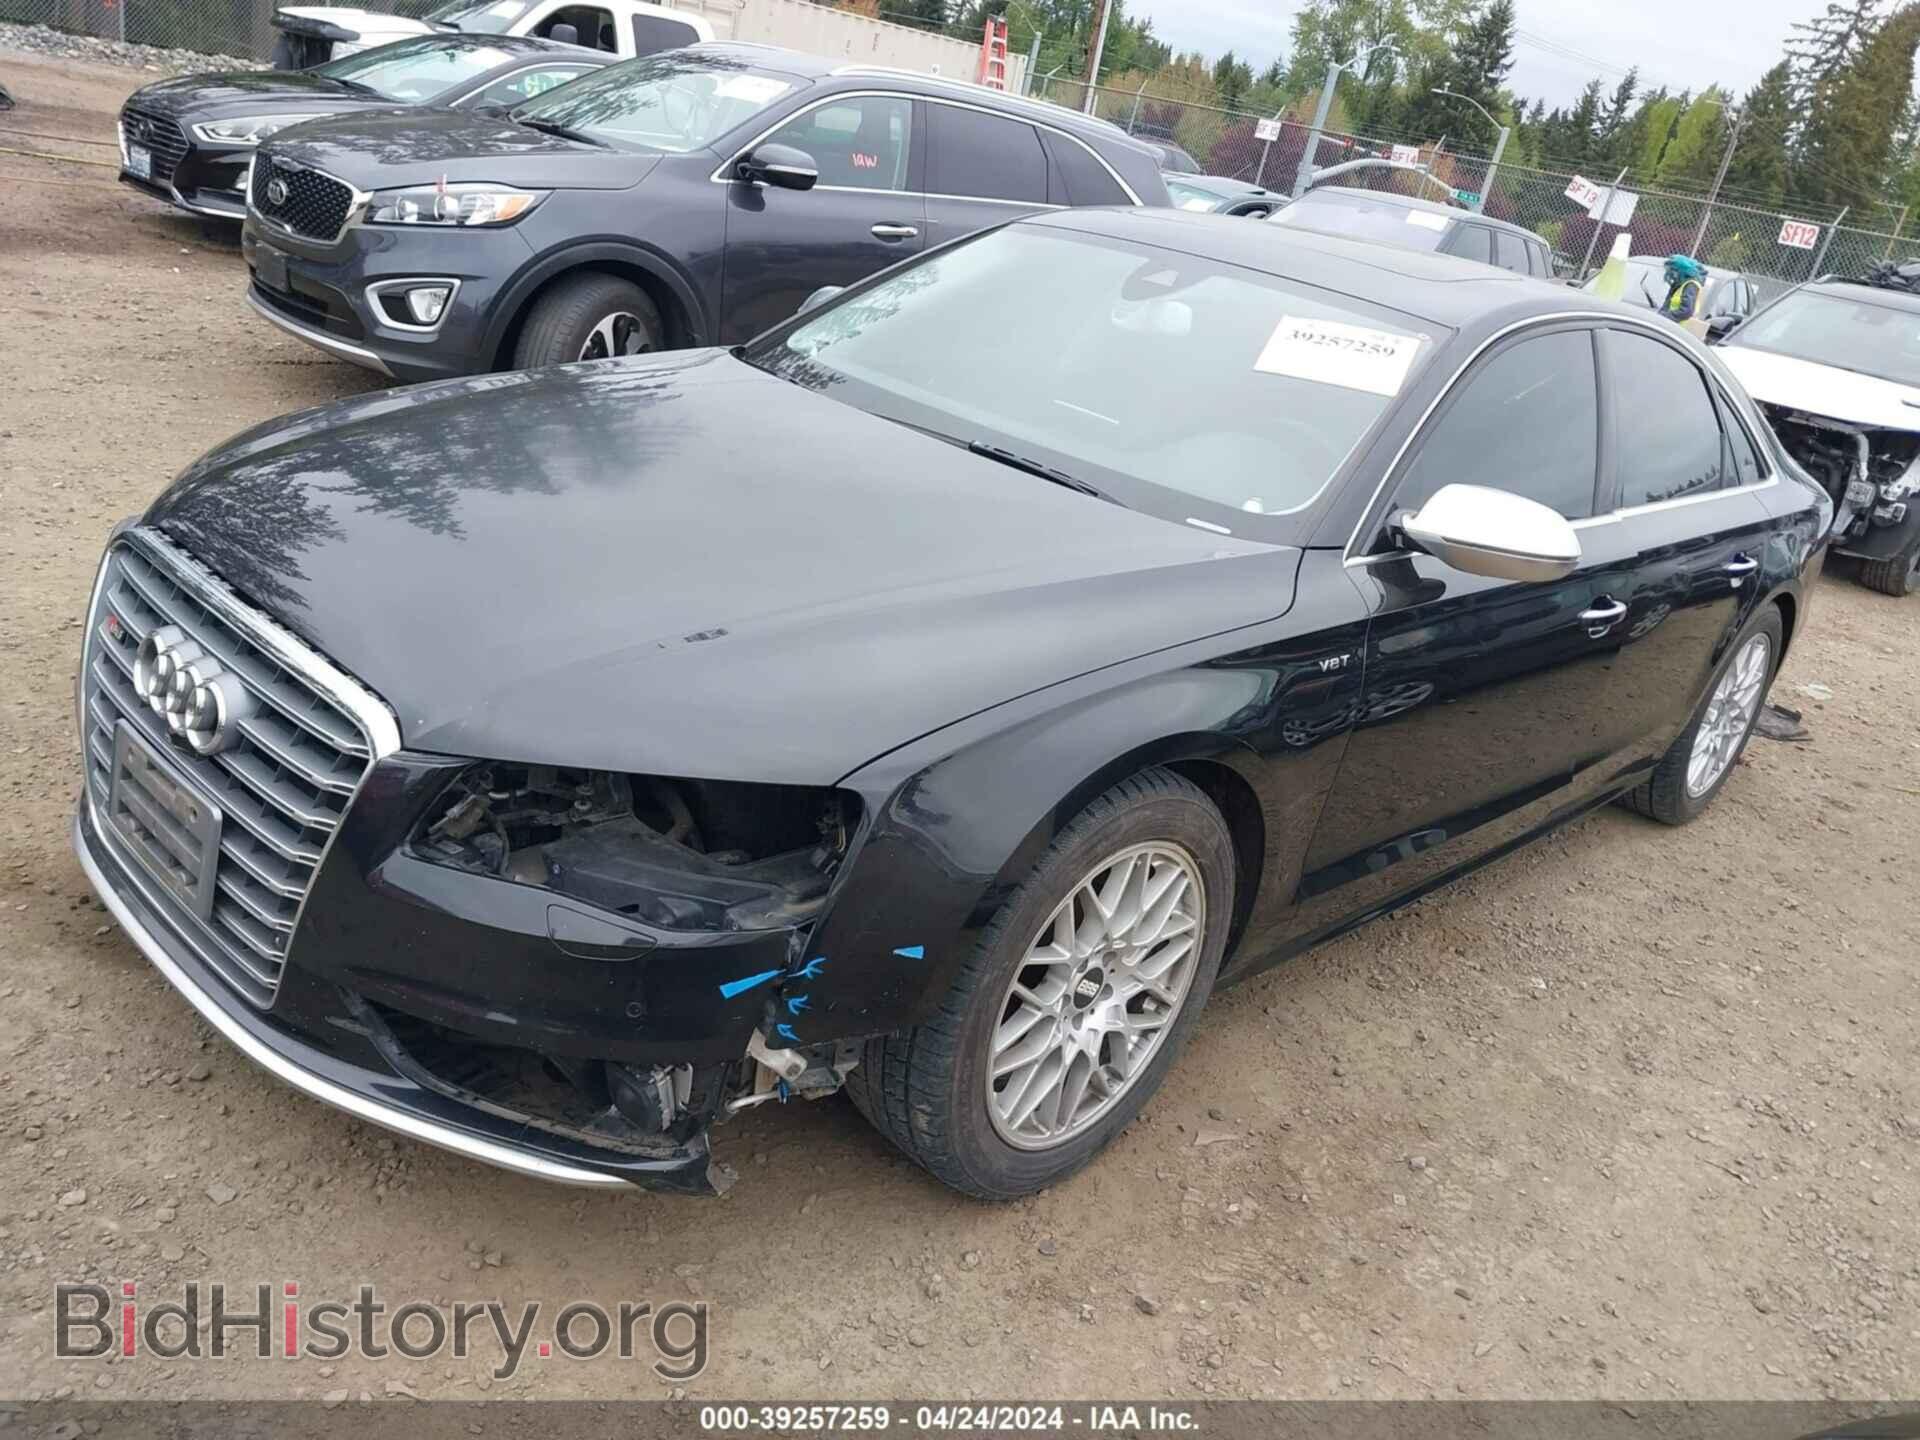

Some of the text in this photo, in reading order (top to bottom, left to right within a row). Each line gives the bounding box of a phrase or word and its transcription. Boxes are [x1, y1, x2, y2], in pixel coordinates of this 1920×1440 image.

[1782, 223, 1816, 246] SF12
[1319, 654, 1350, 672] V8T
[1076, 979, 1100, 998] BBS
